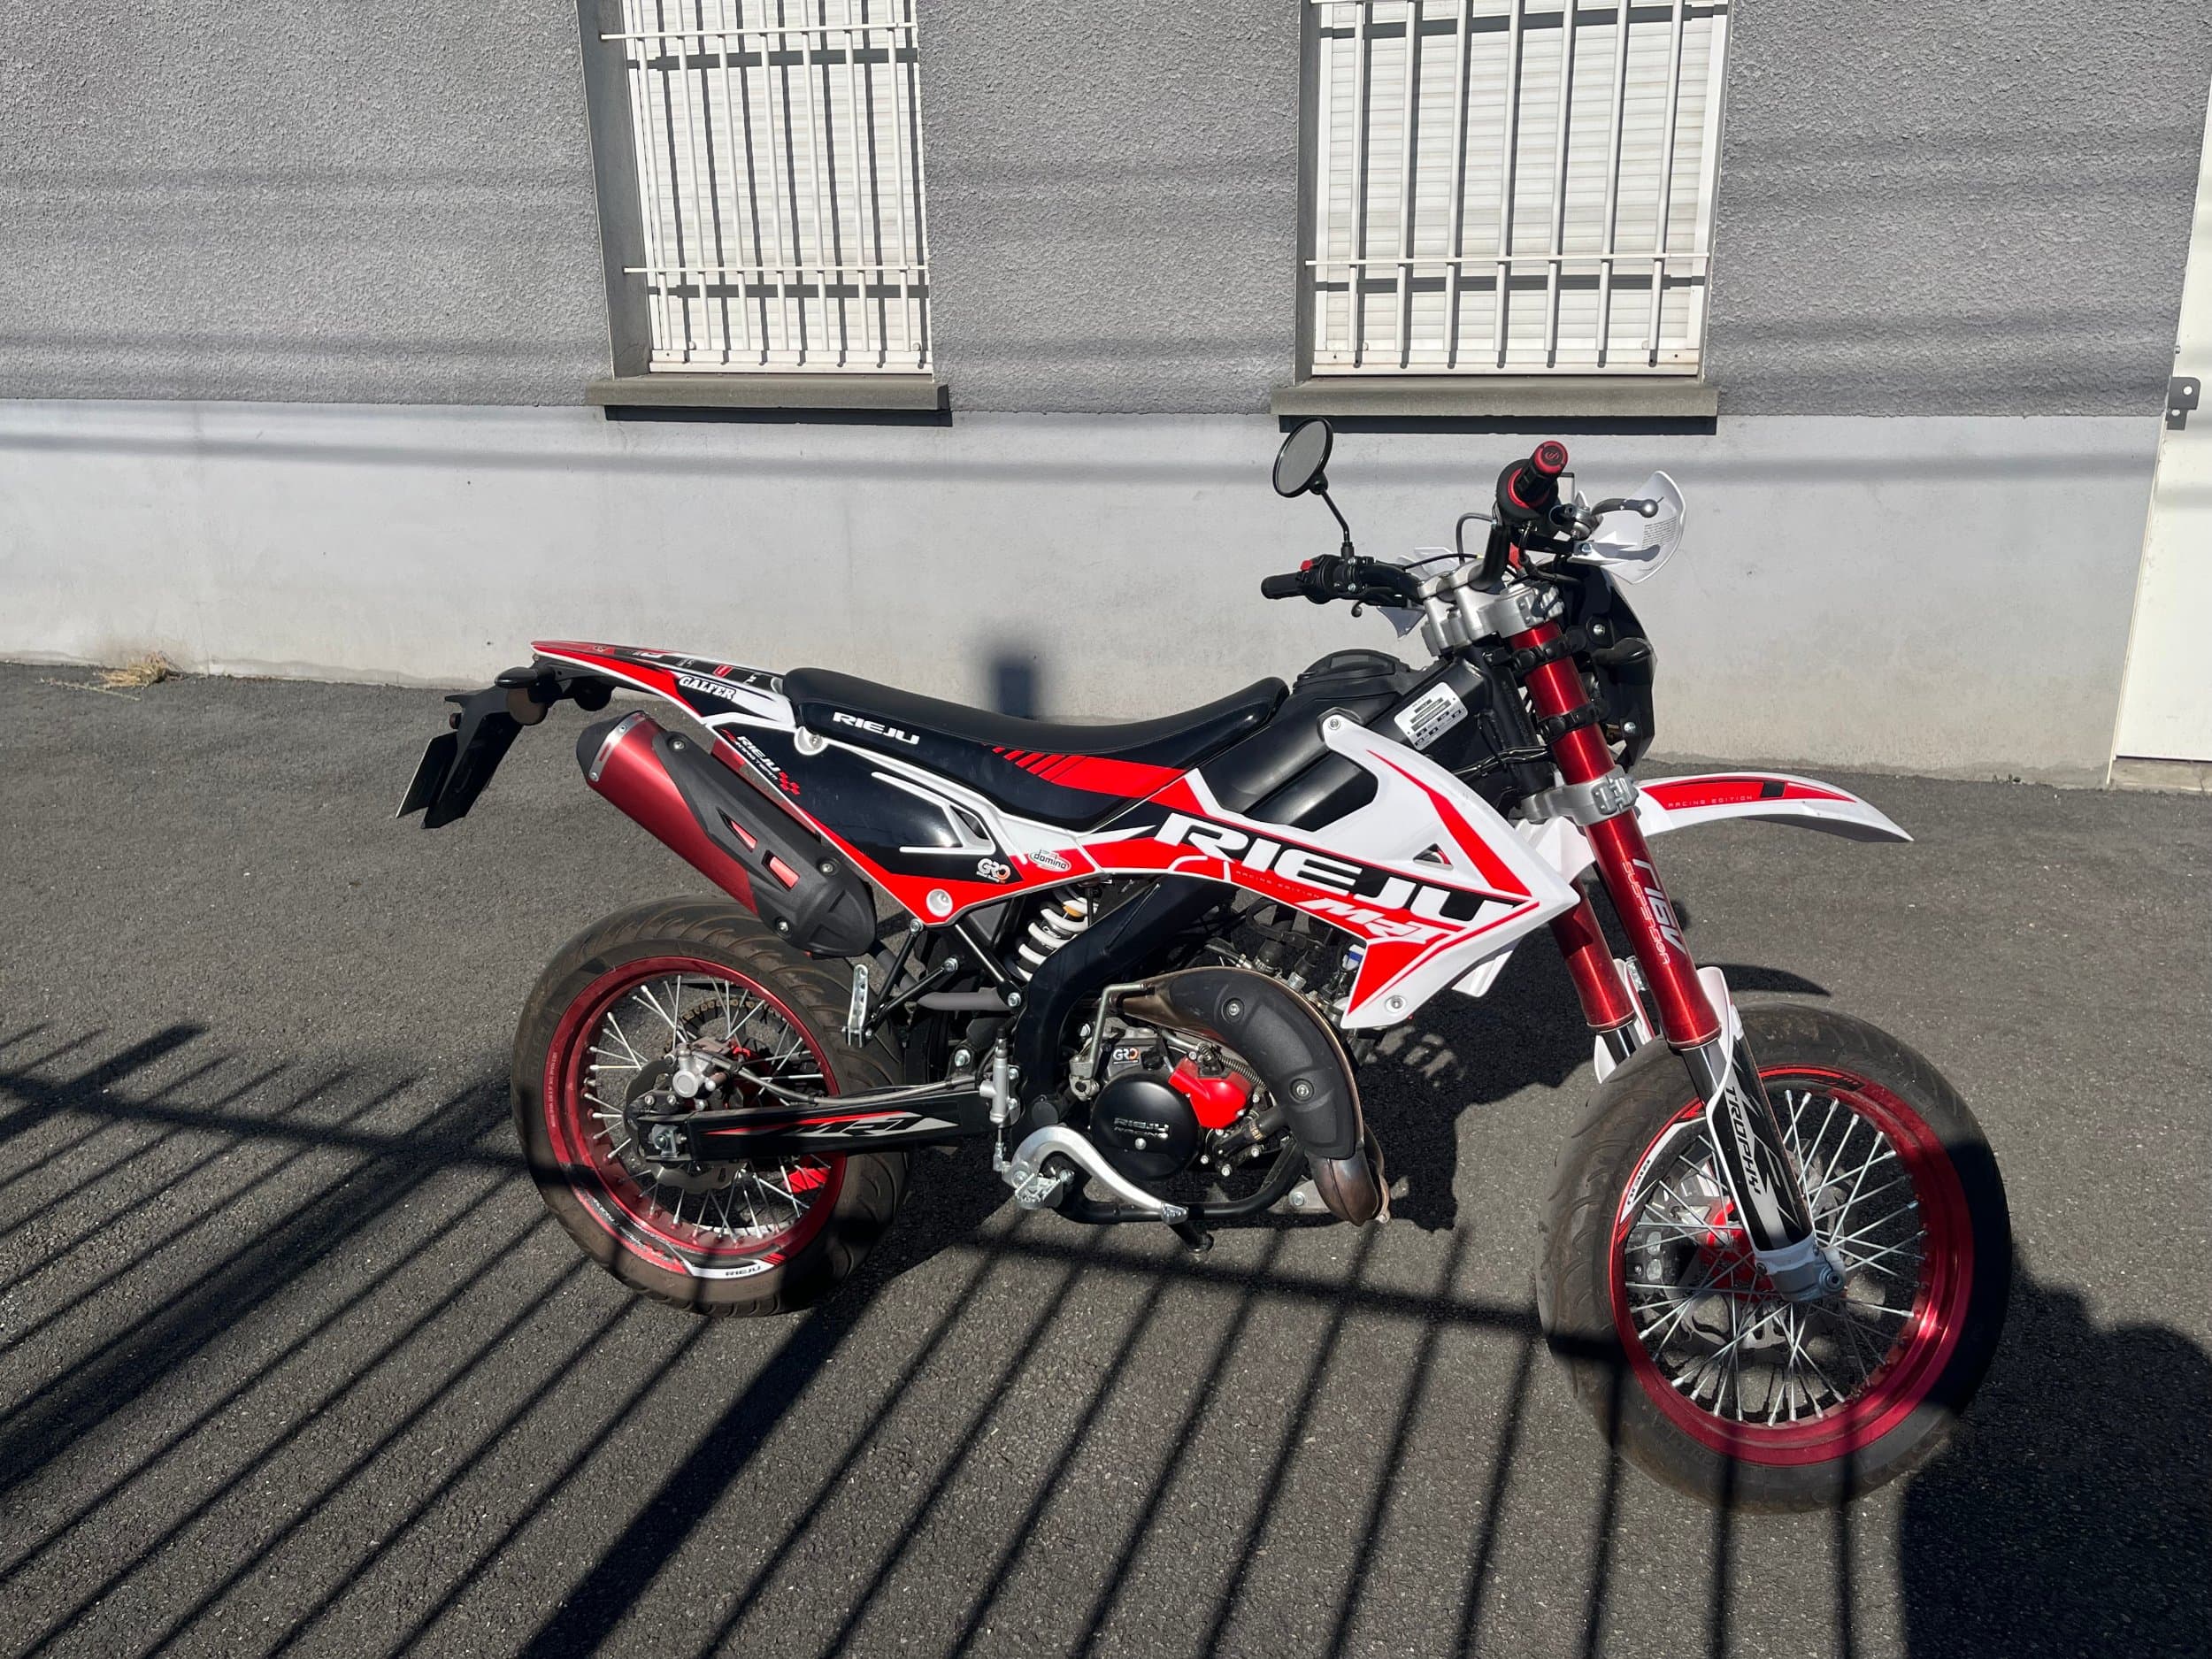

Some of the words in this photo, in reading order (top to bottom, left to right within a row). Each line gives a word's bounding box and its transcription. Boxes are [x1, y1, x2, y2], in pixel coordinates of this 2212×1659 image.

[678, 675, 736, 701] GALFER
[833, 711, 920, 745] RIEJU
[737, 735, 780, 772] RIEJU
[1033, 849, 1068, 870] domino
[1154, 811, 1514, 933] RIEJU
[1294, 897, 1453, 945] MRT
[1113, 1048, 1139, 1061] GRO
[1114, 1118, 1169, 1132] RIEJU
[1725, 1086, 1762, 1195] TROPHY
[726, 1265, 761, 1276] RIEJU
